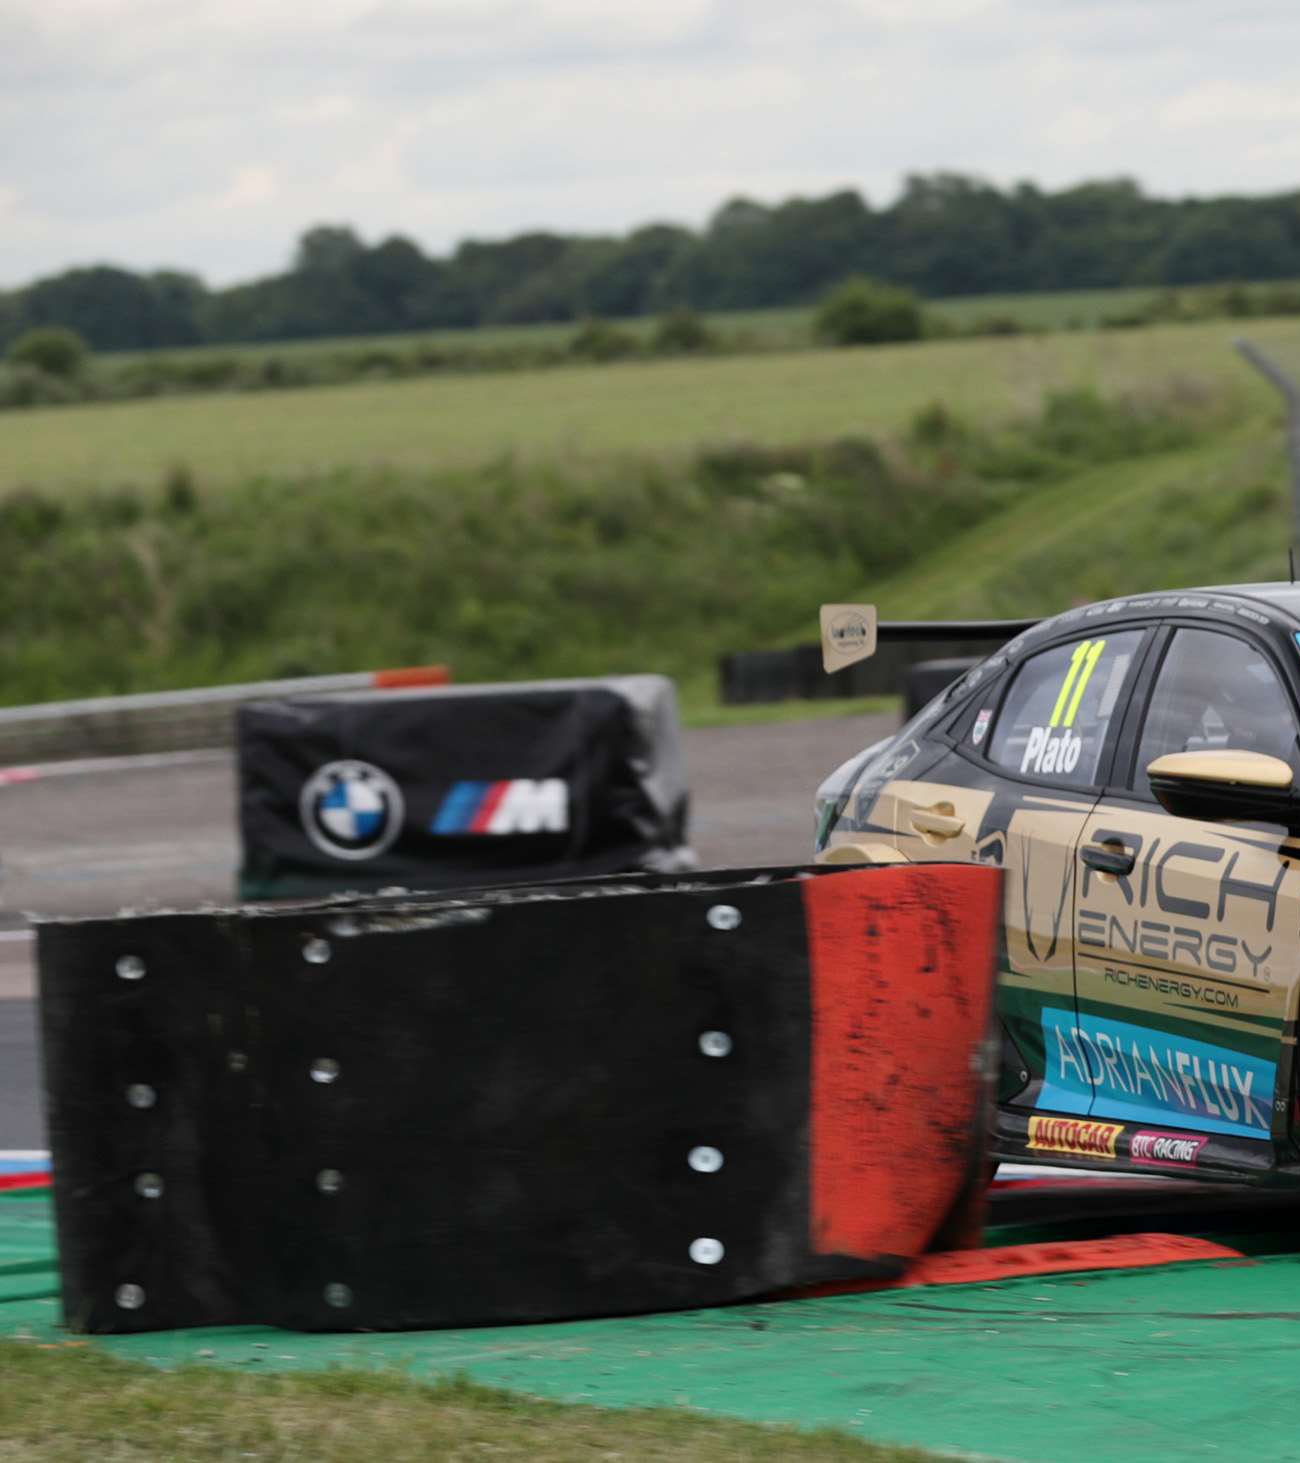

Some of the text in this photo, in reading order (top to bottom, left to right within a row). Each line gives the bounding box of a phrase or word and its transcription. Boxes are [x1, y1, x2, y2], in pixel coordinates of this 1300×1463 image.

[1049, 640, 1106, 728] 11
[1020, 728, 1082, 774] Plato
[1080, 829, 1289, 931] RICH
[1078, 910, 1273, 977] ENERGY
[1104, 969, 1239, 1008] RICHENERGY.COM
[1058, 1024, 1268, 1129] ADRIANFLUX
[1035, 1118, 1115, 1154] AUTOCAR
[1131, 1135, 1198, 1161] BTC RACING
